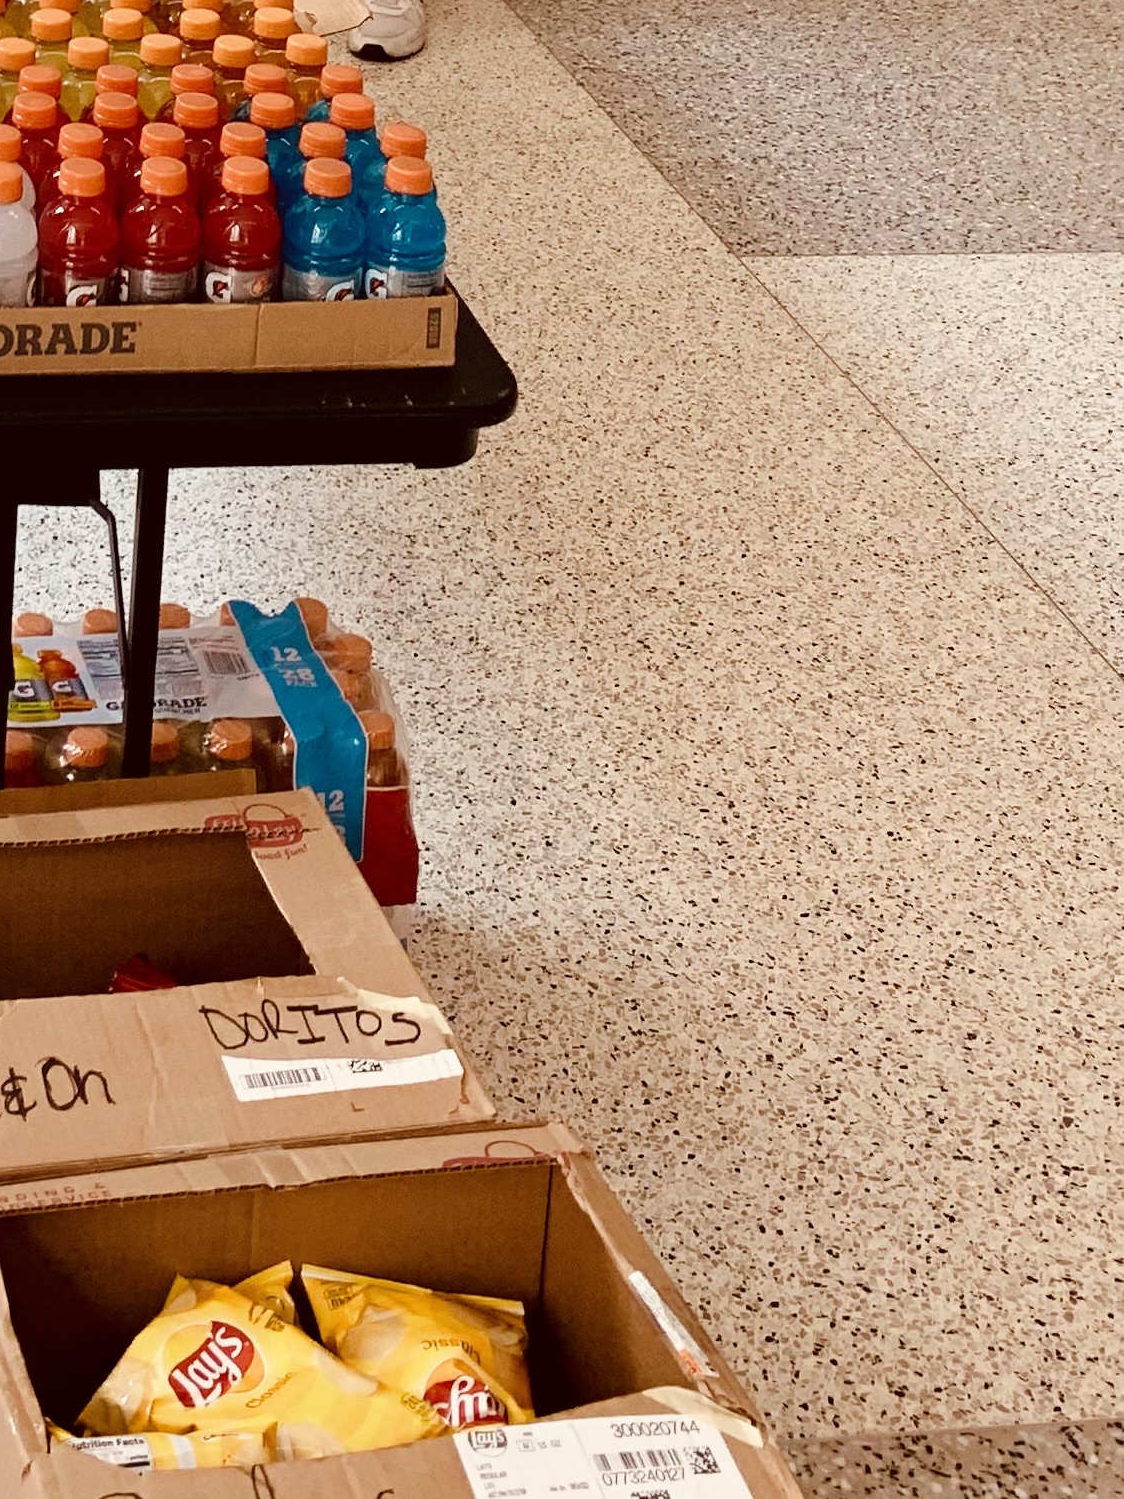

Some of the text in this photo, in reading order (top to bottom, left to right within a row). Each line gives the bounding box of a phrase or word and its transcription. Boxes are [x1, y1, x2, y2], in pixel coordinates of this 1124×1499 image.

[270, 645, 302, 661] 12
[106, 697, 207, 710] GRADE
[200, 998, 422, 1050] DORITOS
[171, 1326, 243, 1409] Lay's
[610, 1420, 700, 1439] 300020744
[116, 1437, 145, 1446] Facts
